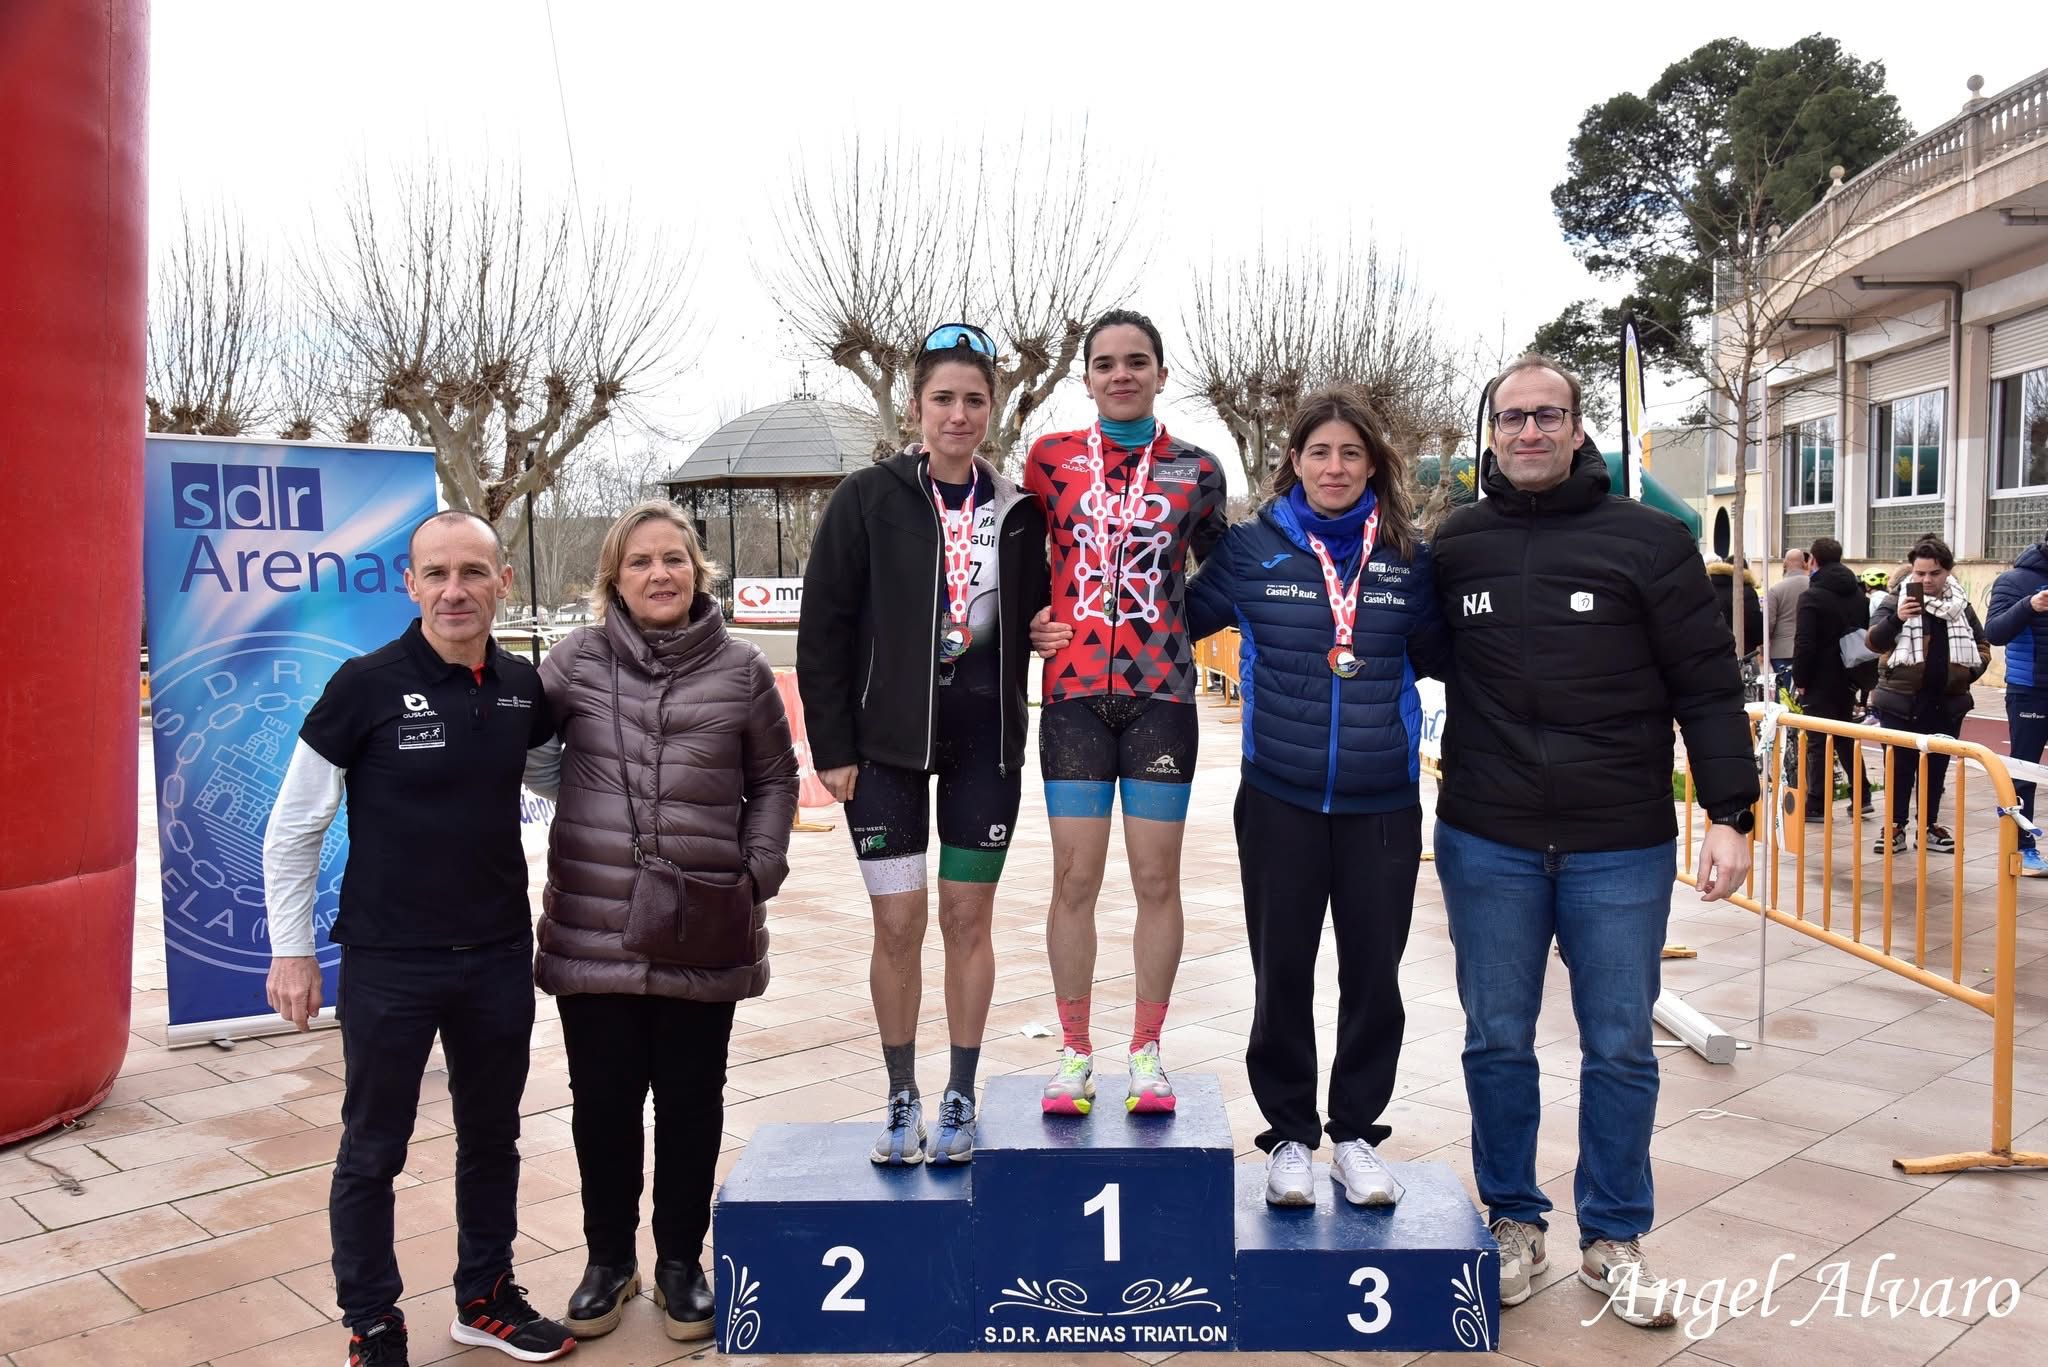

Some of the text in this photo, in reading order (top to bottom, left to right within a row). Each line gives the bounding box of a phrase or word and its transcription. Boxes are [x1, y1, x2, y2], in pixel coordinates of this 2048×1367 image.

[182, 468, 310, 528] sdr
[1387, 564, 1411, 575] Arenas
[1265, 588, 1318, 600] Castel Ruiz
[1363, 595, 1406, 606] Castel Ruiz
[1463, 591, 1494, 617] NA
[1083, 1183, 1121, 1262] 1
[821, 1245, 866, 1312] 2
[1347, 1266, 1392, 1334] 3
[984, 1325, 1228, 1343] S.D.R. ARENAS TRIATLON
